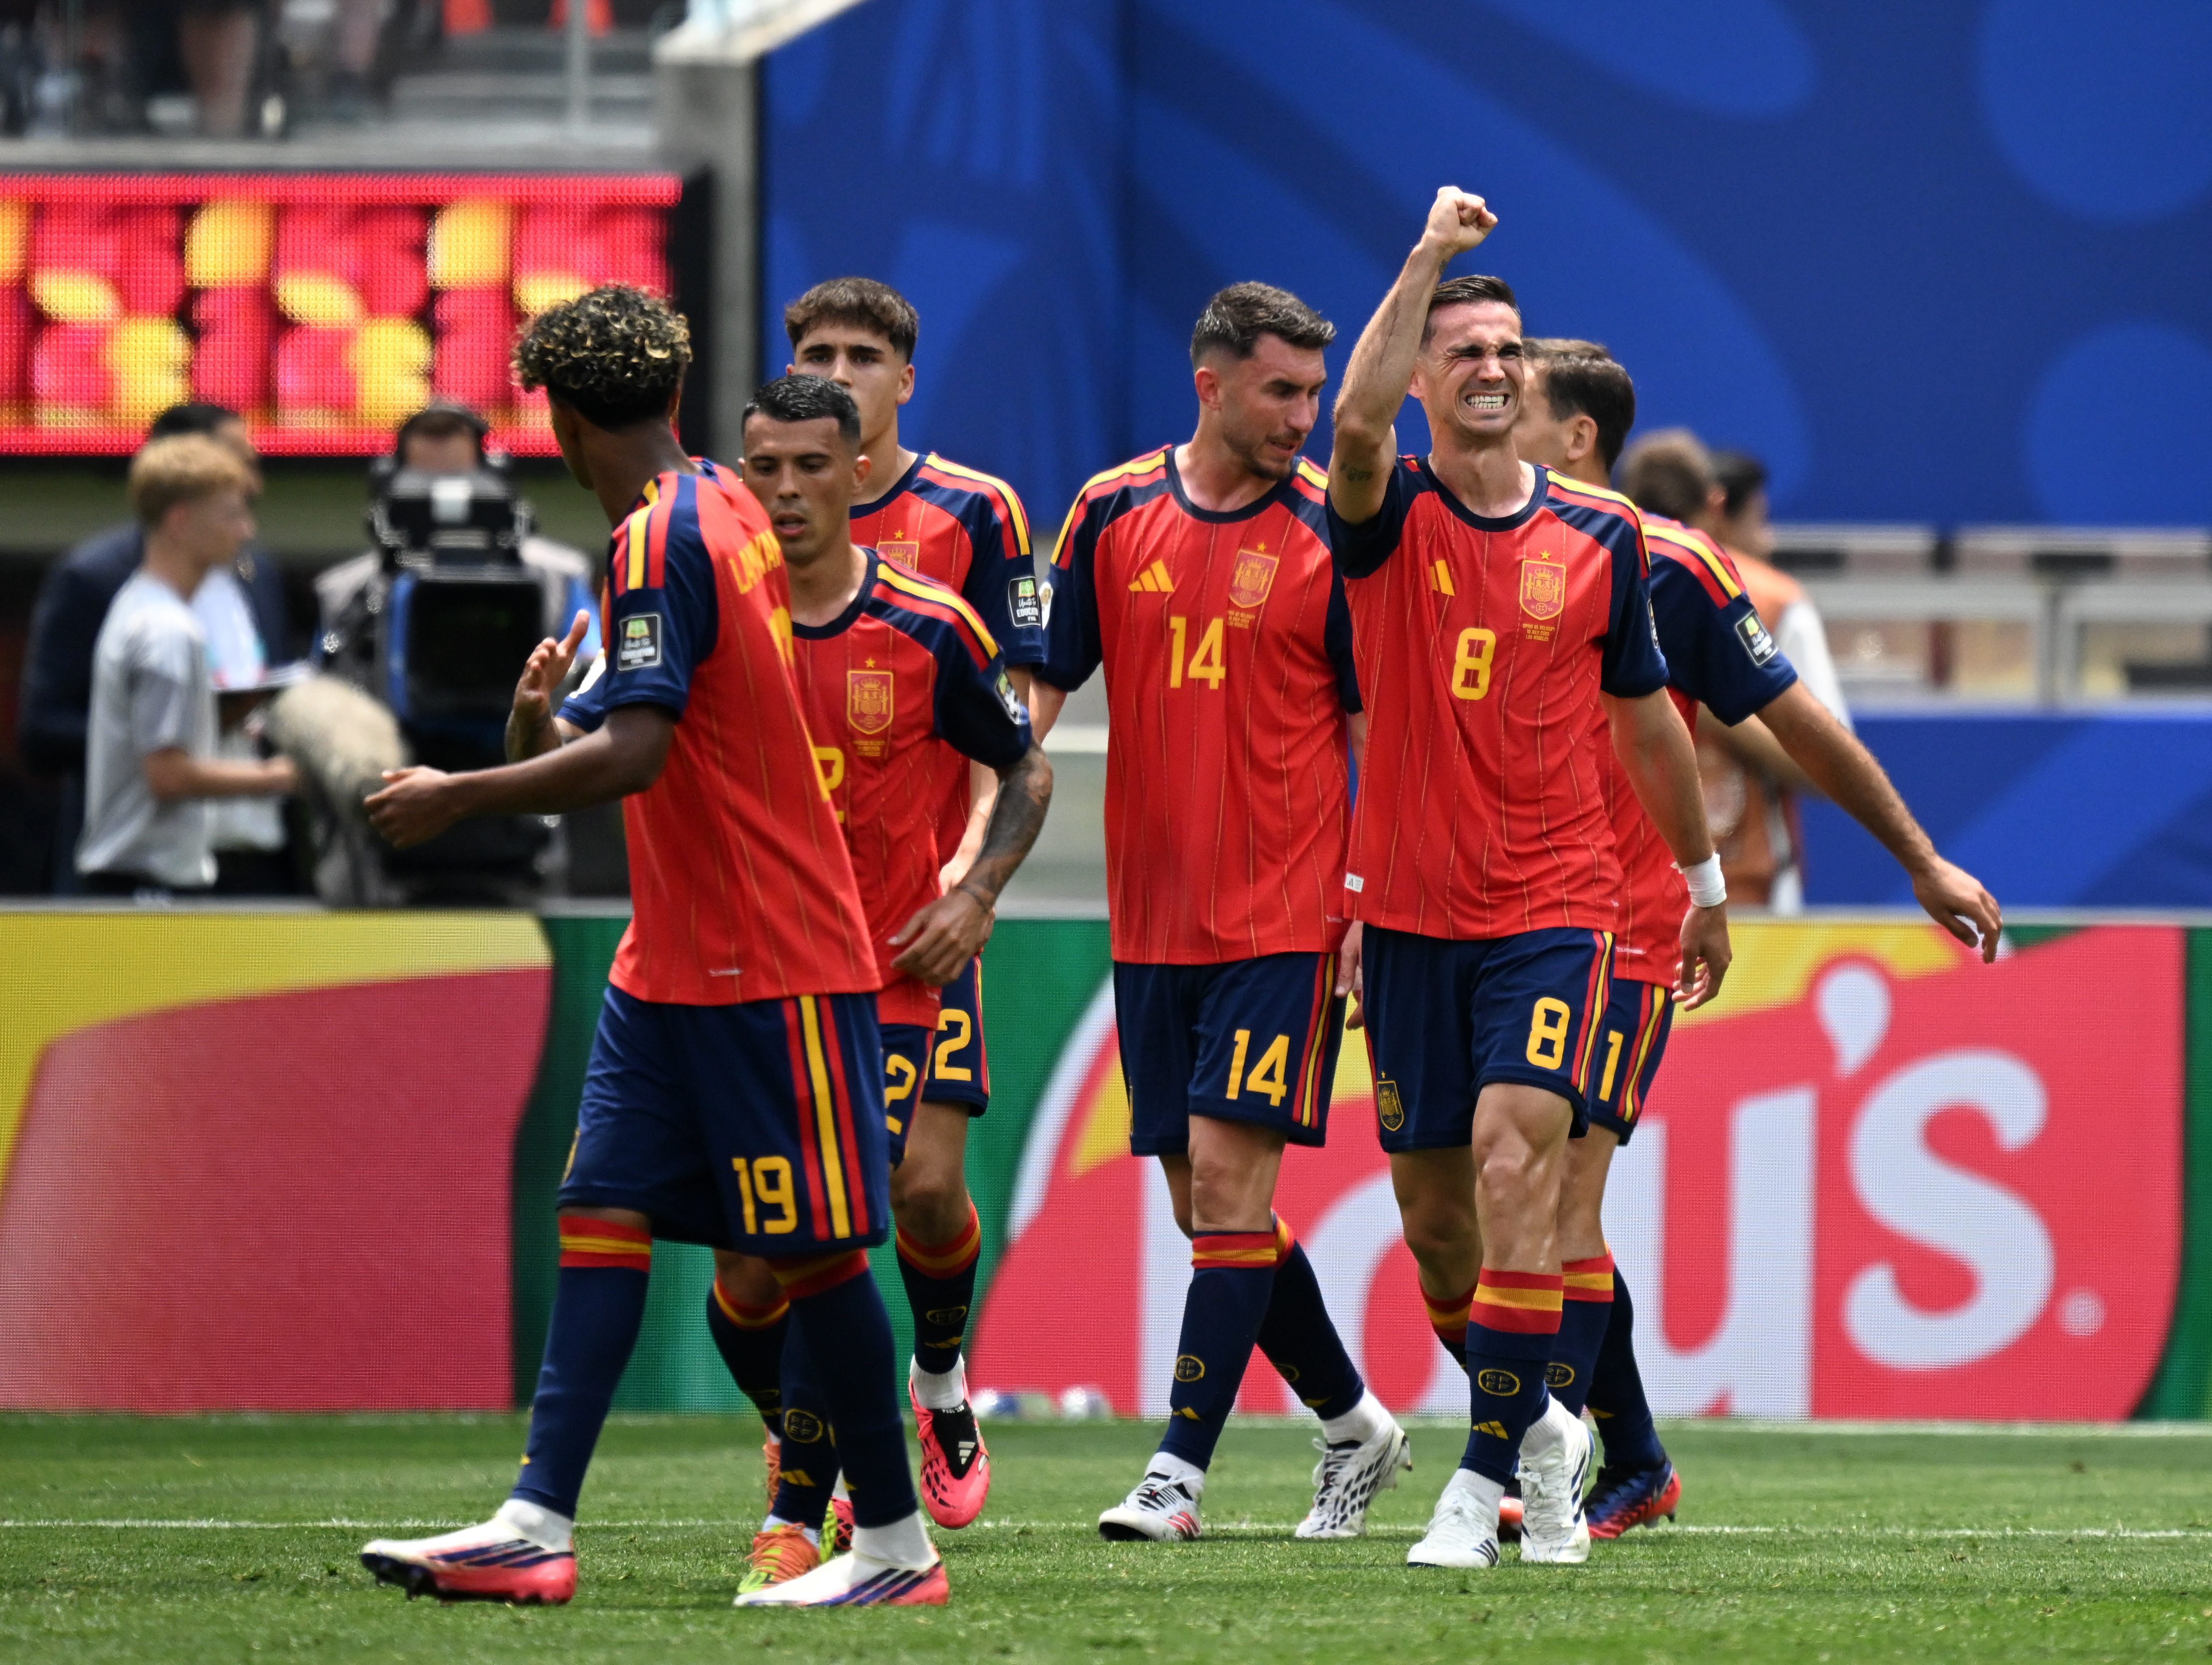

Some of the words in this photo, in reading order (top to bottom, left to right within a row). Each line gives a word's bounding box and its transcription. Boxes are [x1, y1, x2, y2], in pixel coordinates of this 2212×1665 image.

[1170, 616, 1226, 689] 14
[1452, 627, 1496, 700] 8
[935, 1009, 971, 1082] 2
[1226, 1029, 1290, 1107] 14
[1526, 997, 1570, 1070] 8
[1599, 1030, 1624, 1102] 1
[884, 1053, 917, 1135] 2
[731, 1156, 798, 1235] 19
